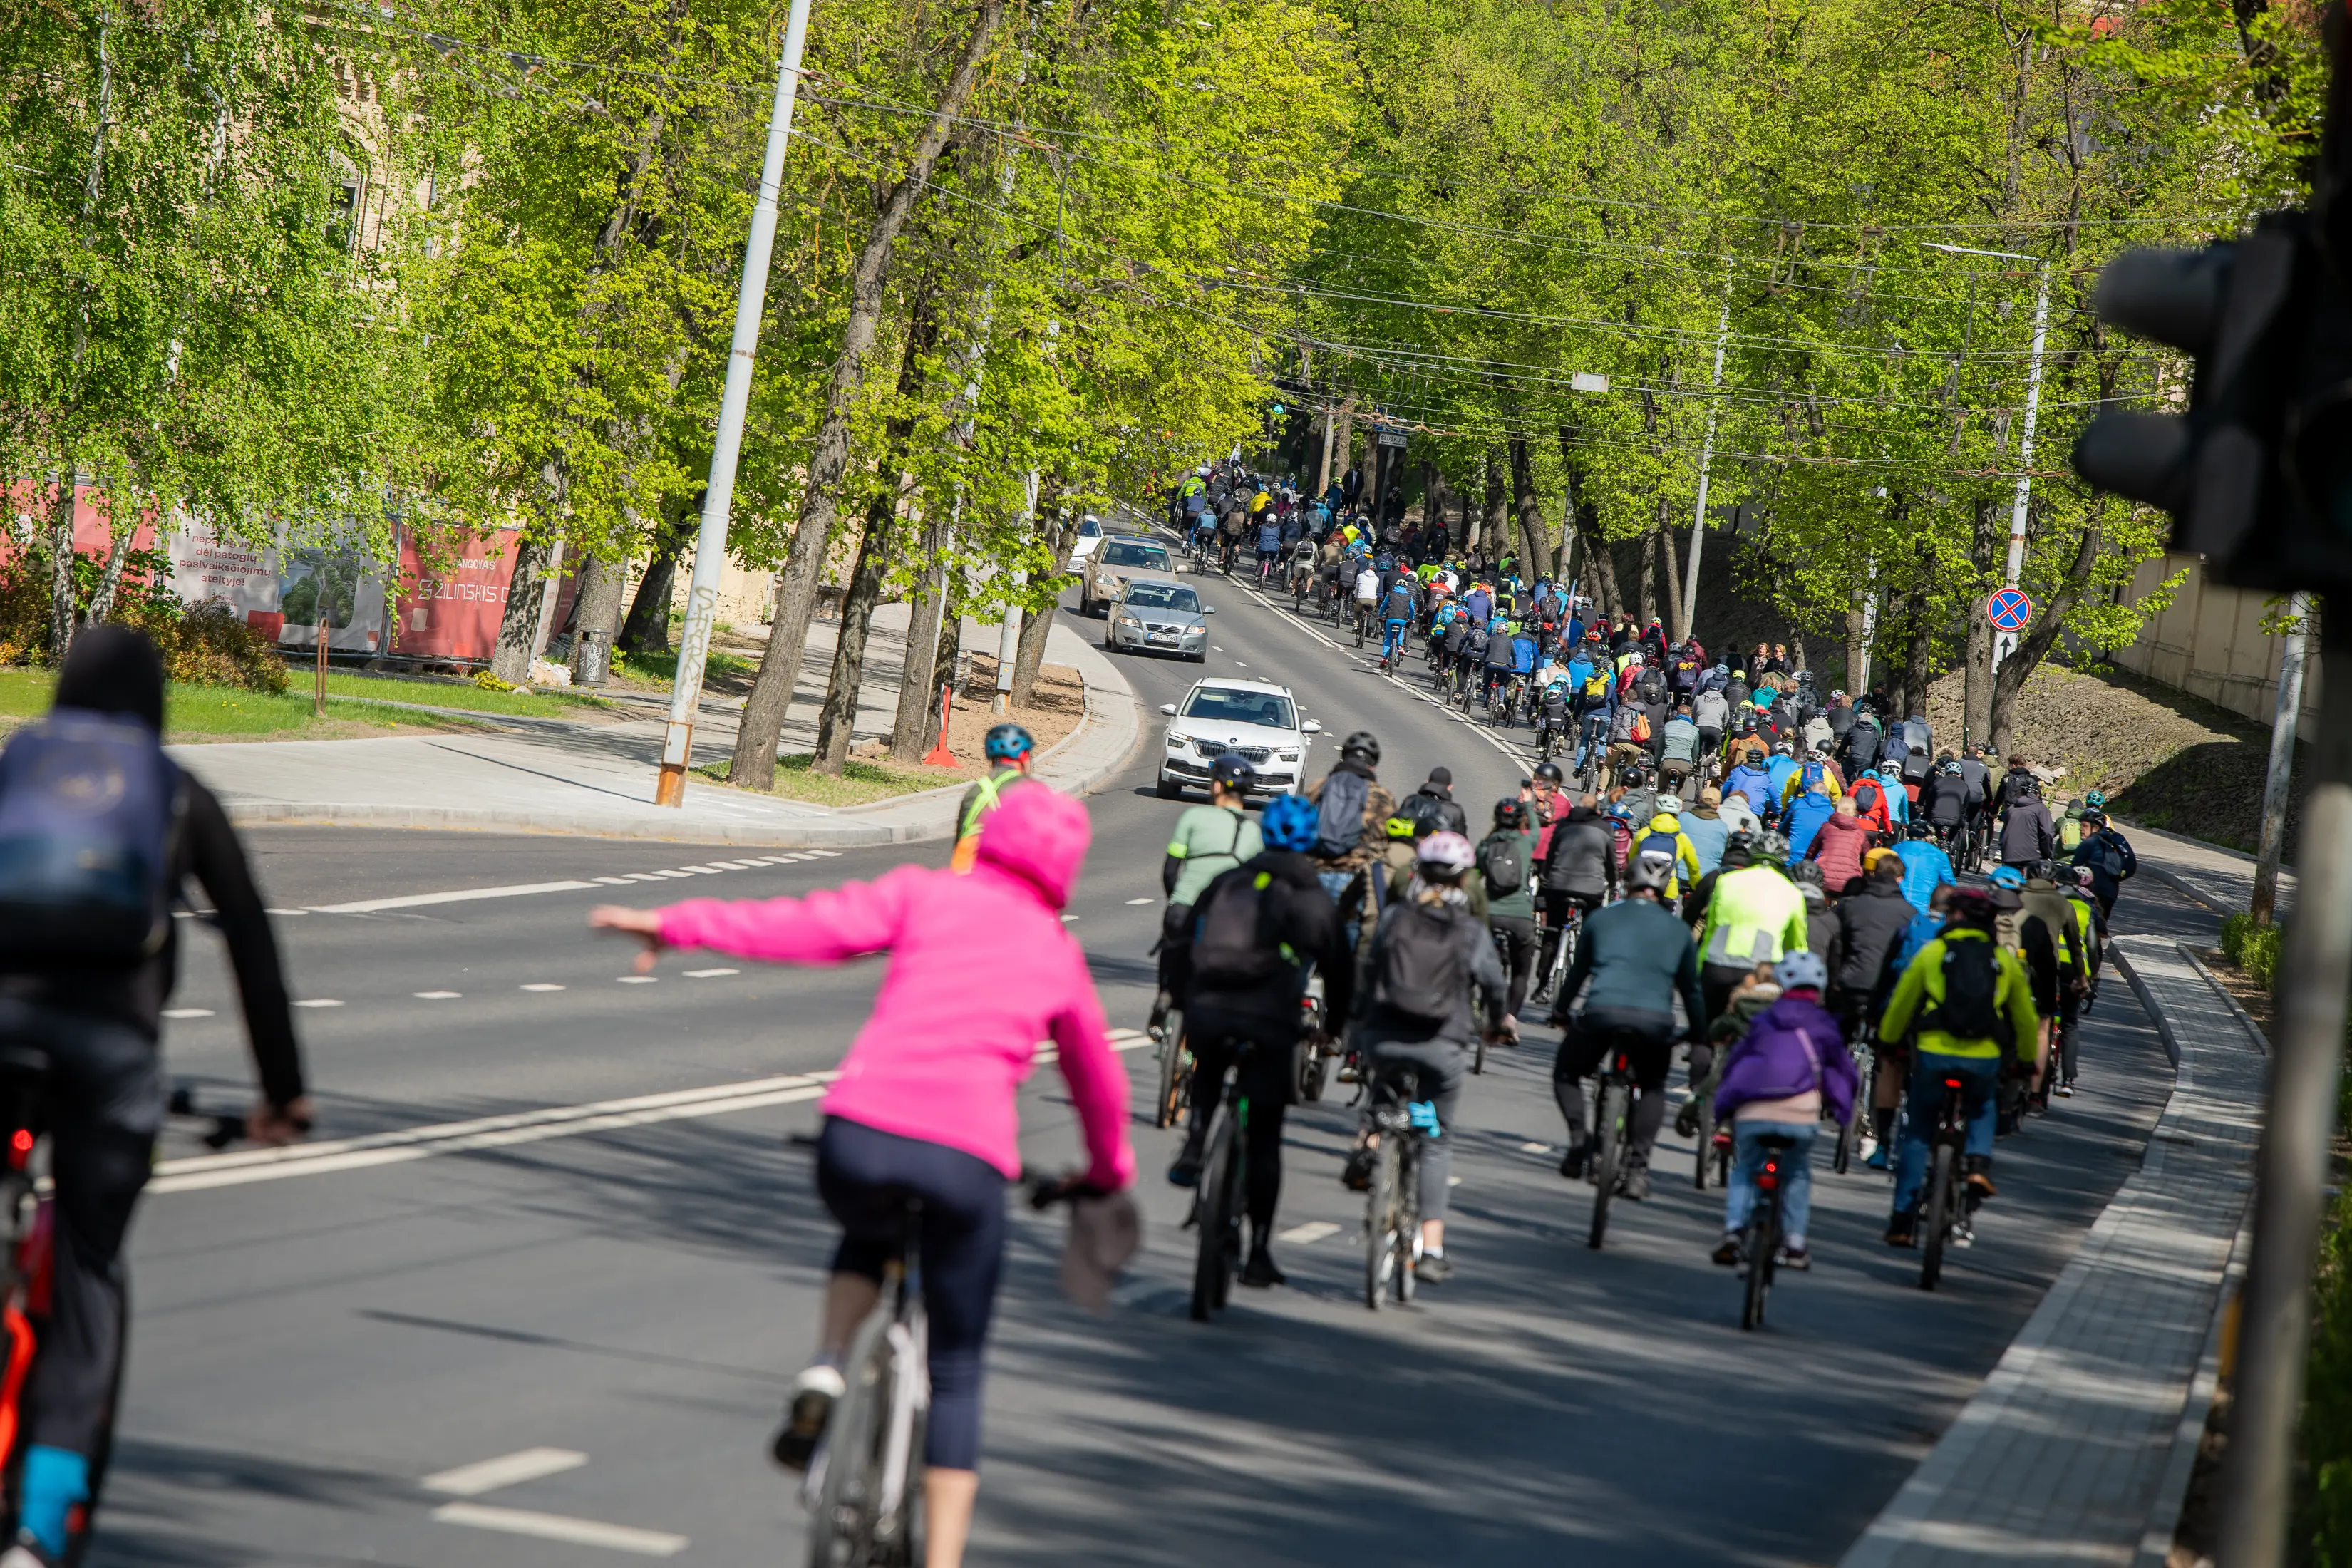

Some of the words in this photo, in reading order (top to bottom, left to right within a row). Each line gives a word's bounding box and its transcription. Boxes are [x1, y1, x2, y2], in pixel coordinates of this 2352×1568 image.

[196, 548, 212, 557] dėl
[215, 551, 257, 564] patogių
[179, 559, 271, 578] pasivaikščiojimų
[201, 574, 245, 587] ateityje!
